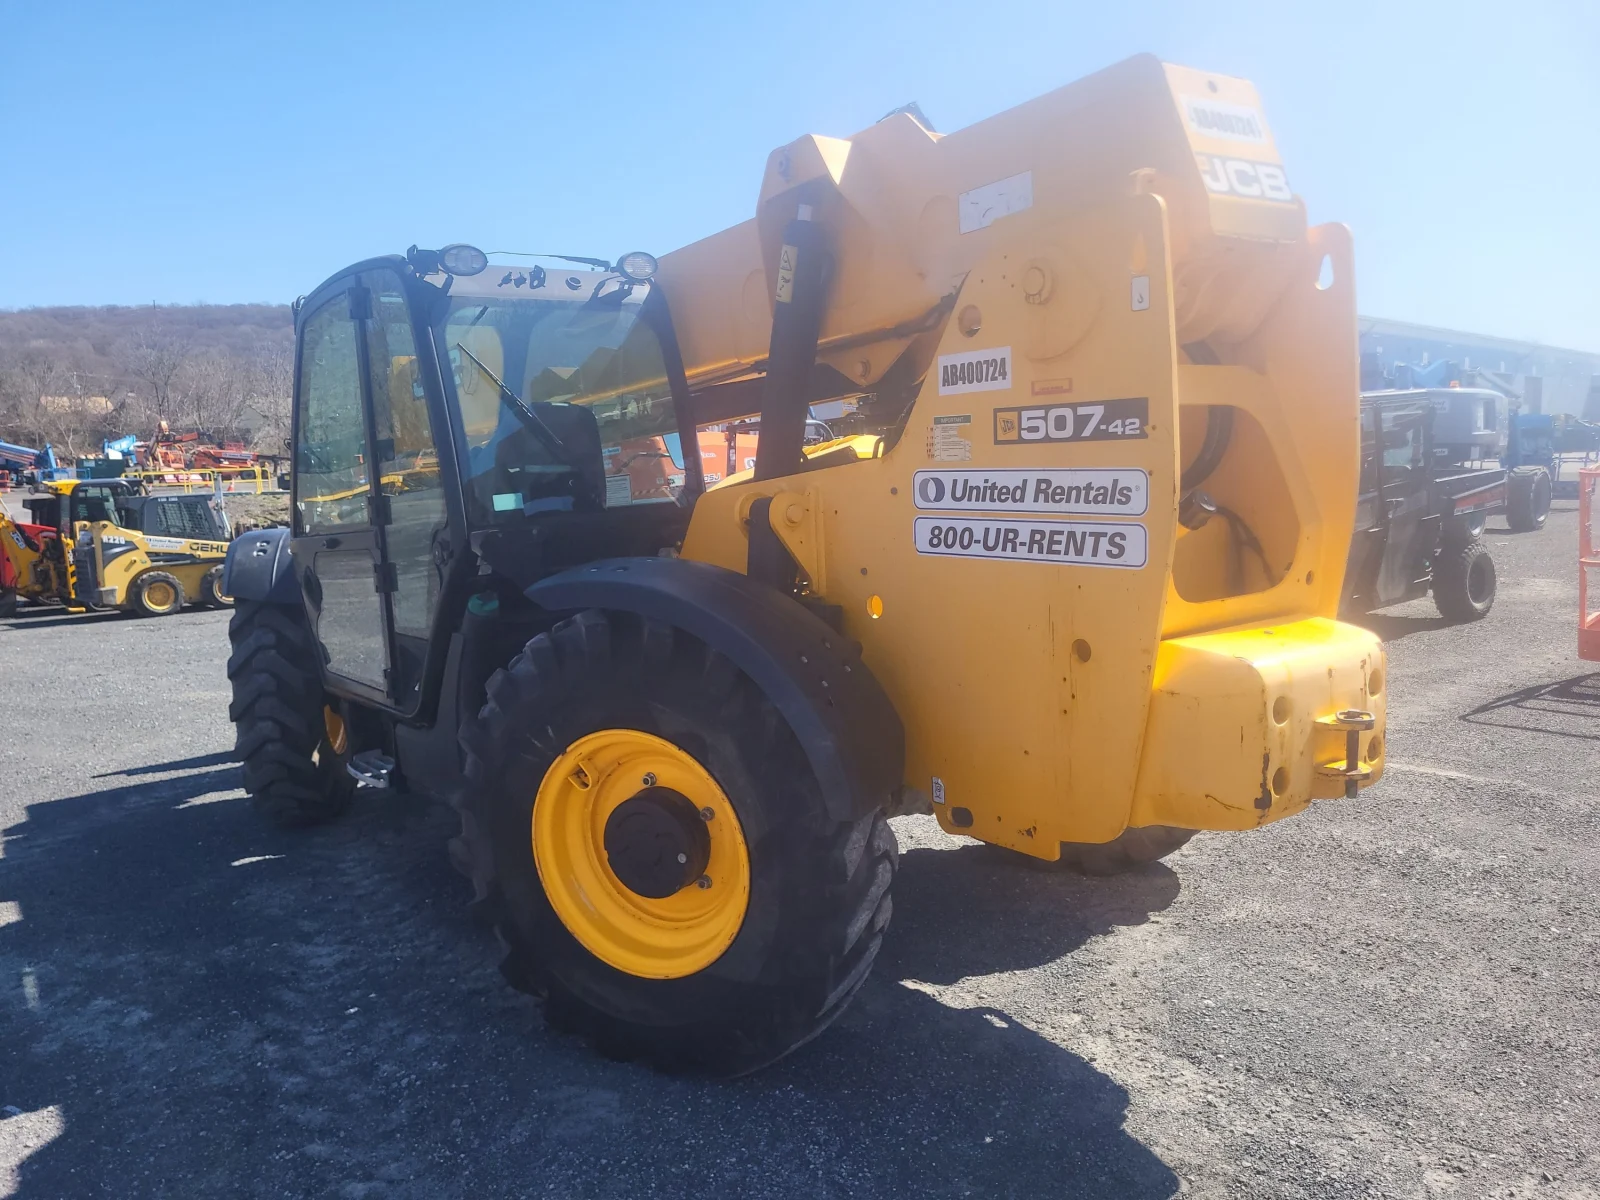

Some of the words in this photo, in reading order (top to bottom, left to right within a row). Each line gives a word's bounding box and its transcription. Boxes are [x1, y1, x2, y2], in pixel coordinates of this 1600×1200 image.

[1202, 157, 1292, 200] JCB
[942, 357, 1007, 387] AB400724
[951, 479, 1028, 504] United
[1033, 479, 1132, 506] Rentals
[928, 525, 1127, 559] 800-UR-RENTS
